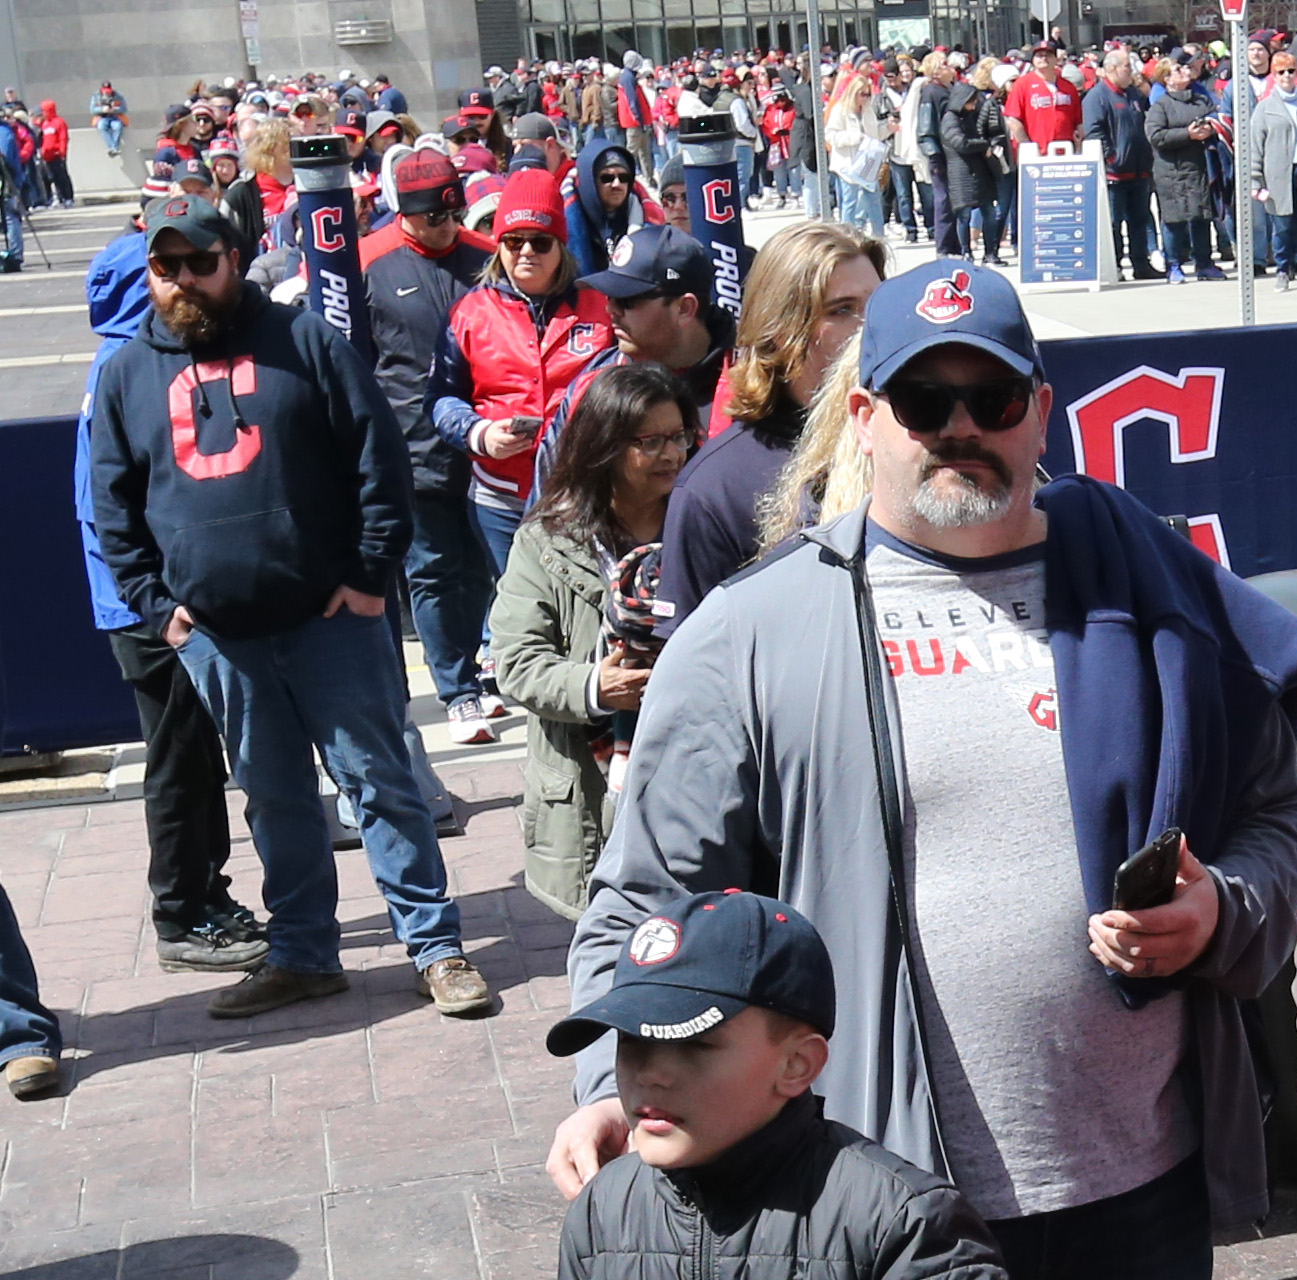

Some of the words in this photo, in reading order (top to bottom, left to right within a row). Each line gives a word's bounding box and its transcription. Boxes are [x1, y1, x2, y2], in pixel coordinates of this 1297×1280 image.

[701, 179, 735, 224] C
[310, 206, 346, 253] C
[568, 323, 594, 357] C
[168, 354, 262, 480] C
[640, 1006, 725, 1040] GUARDIANS
